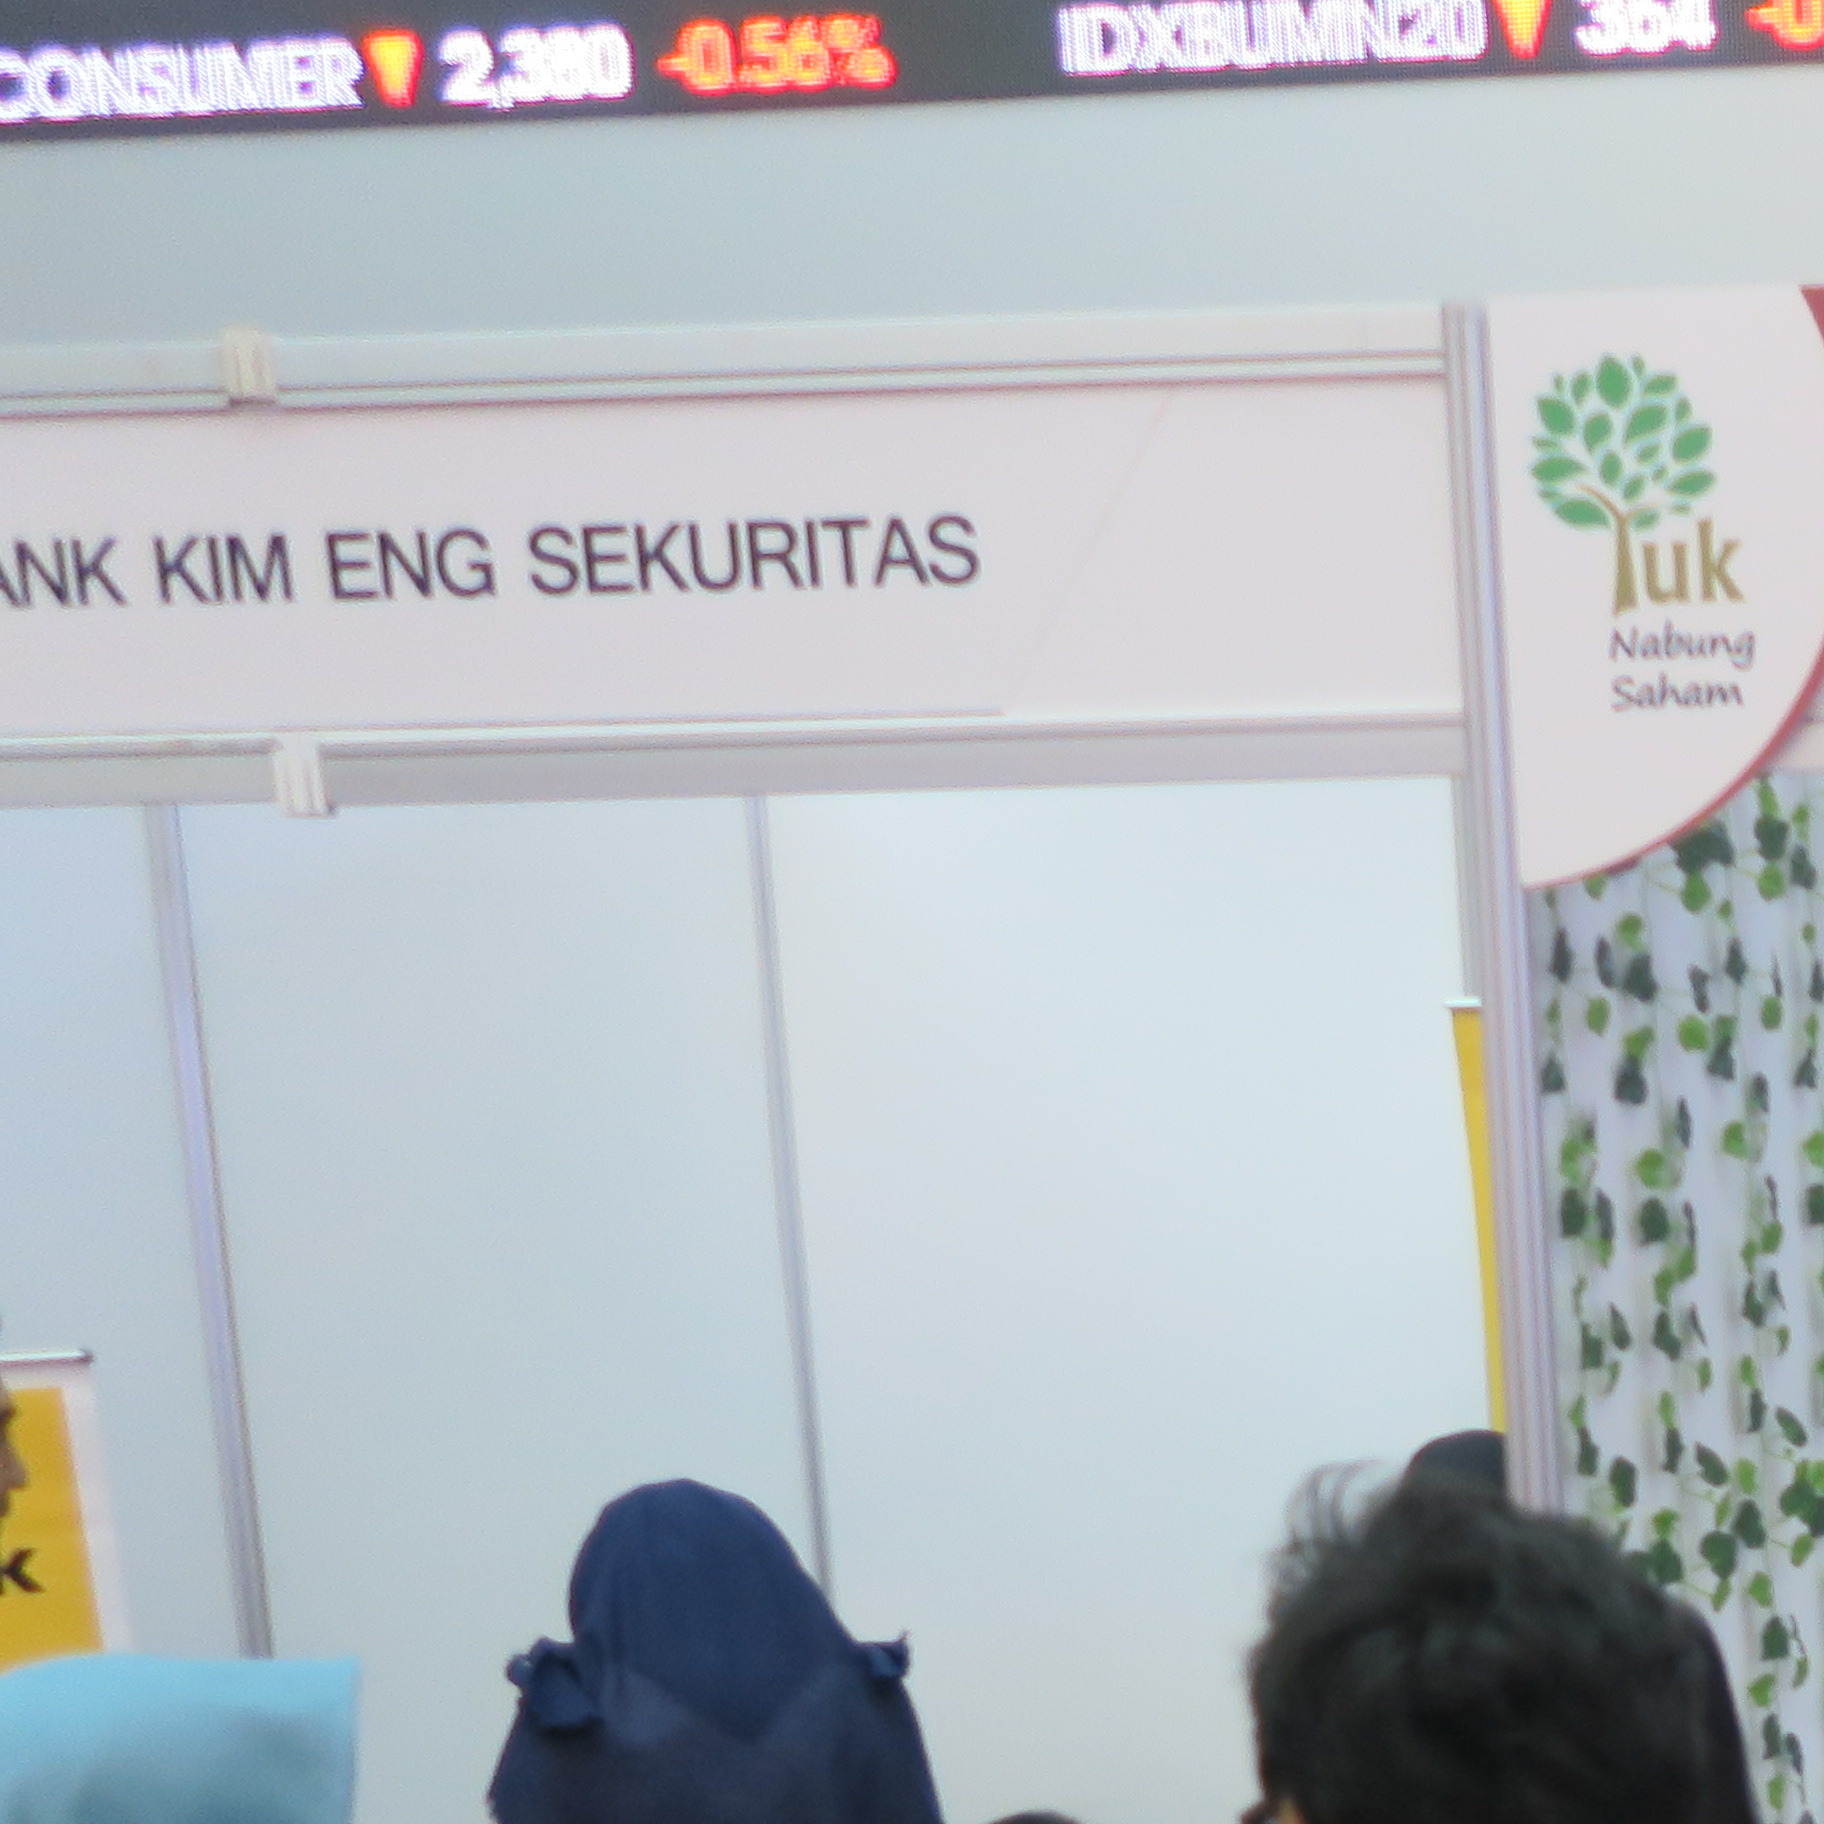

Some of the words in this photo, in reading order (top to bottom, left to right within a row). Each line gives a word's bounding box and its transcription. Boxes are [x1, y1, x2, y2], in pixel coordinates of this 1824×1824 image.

[152, 533, 294, 604] KIM
[324, 528, 496, 601] ENG
[527, 515, 980, 598] SEKURITAS
[1608, 620, 1757, 670] Nabung
[1610, 673, 1745, 712] Saham
